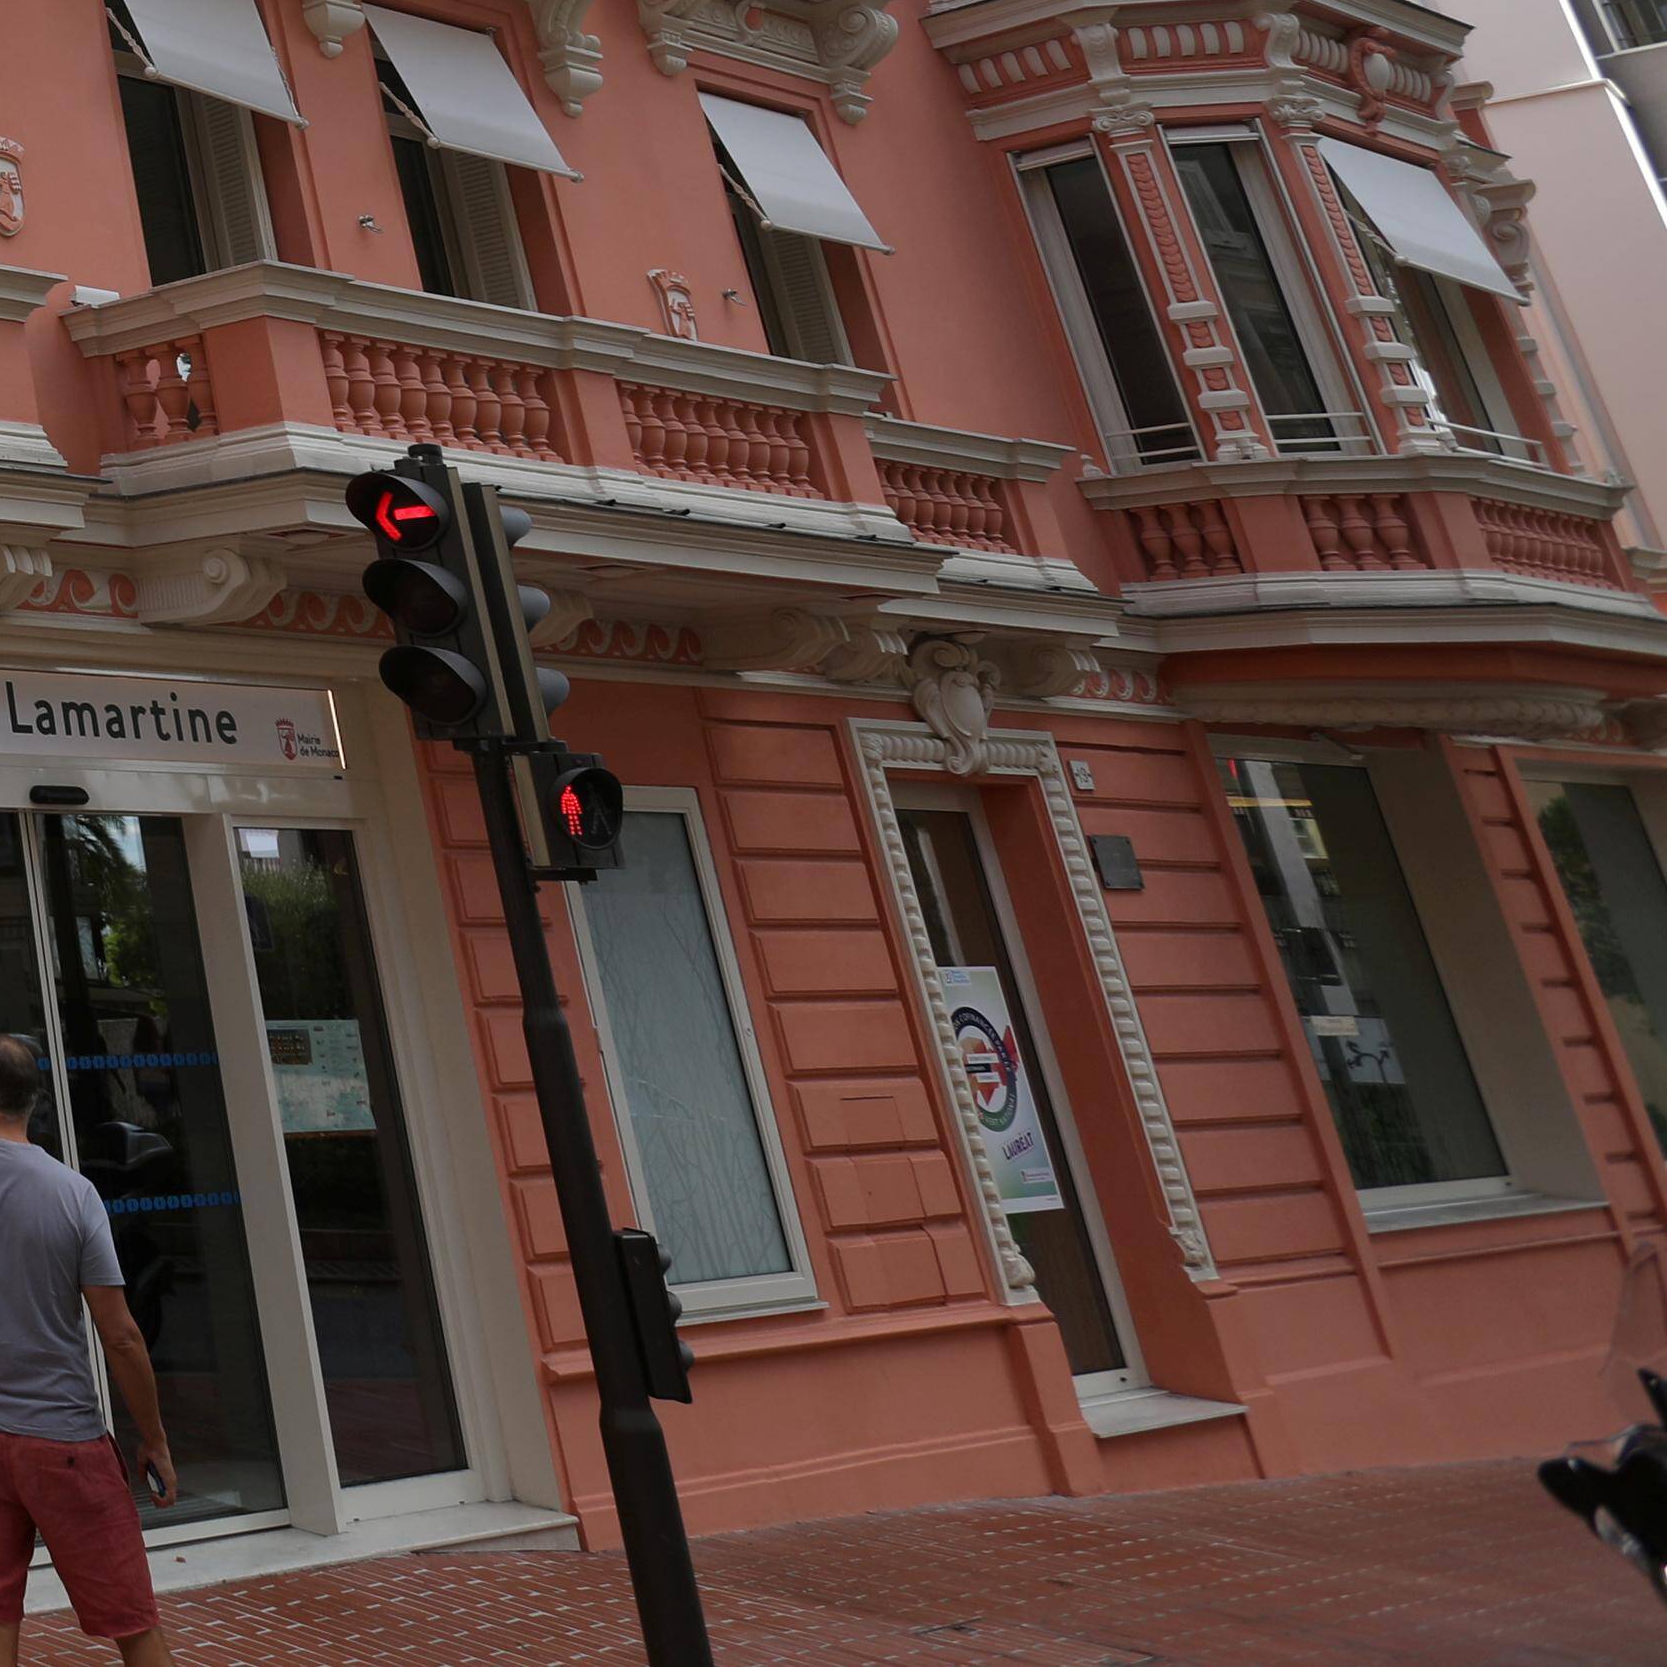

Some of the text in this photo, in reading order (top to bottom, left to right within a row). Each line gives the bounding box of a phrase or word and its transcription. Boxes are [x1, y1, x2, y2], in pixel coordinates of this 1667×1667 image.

[5, 681, 238, 745] Lamartine
[297, 734, 321, 745] Mairie
[299, 746, 339, 758] de Monaco
[1002, 1131, 1034, 1160] LAURÉAT
